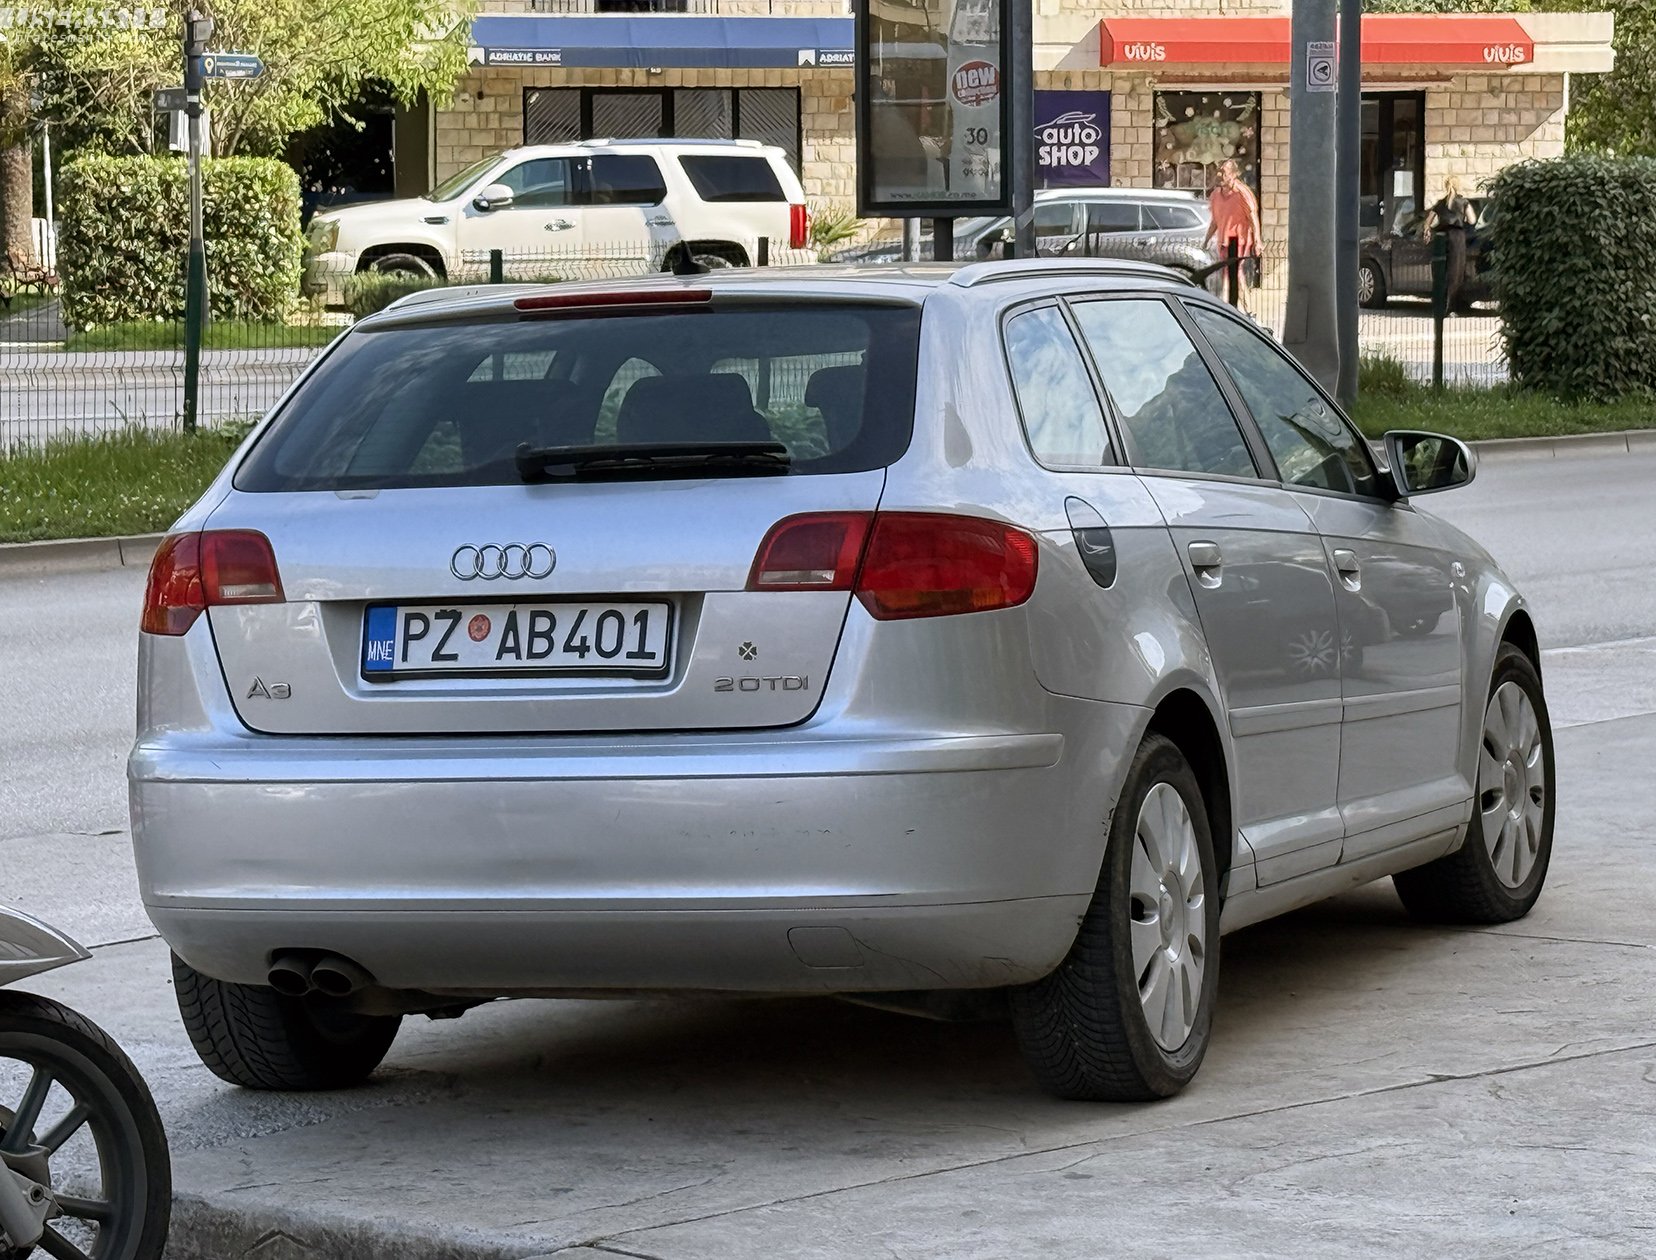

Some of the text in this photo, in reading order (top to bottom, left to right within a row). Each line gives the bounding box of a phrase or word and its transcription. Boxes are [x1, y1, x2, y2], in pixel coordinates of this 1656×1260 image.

[489, 52, 533, 62] ADRIATIC
[956, 66, 996, 90] new
[964, 127, 988, 145] 30
[1042, 123, 1097, 144] auto
[1039, 145, 1099, 168] SHOP
[367, 640, 394, 661] MNE
[495, 609, 657, 661] AB401
[247, 675, 292, 699] A3
